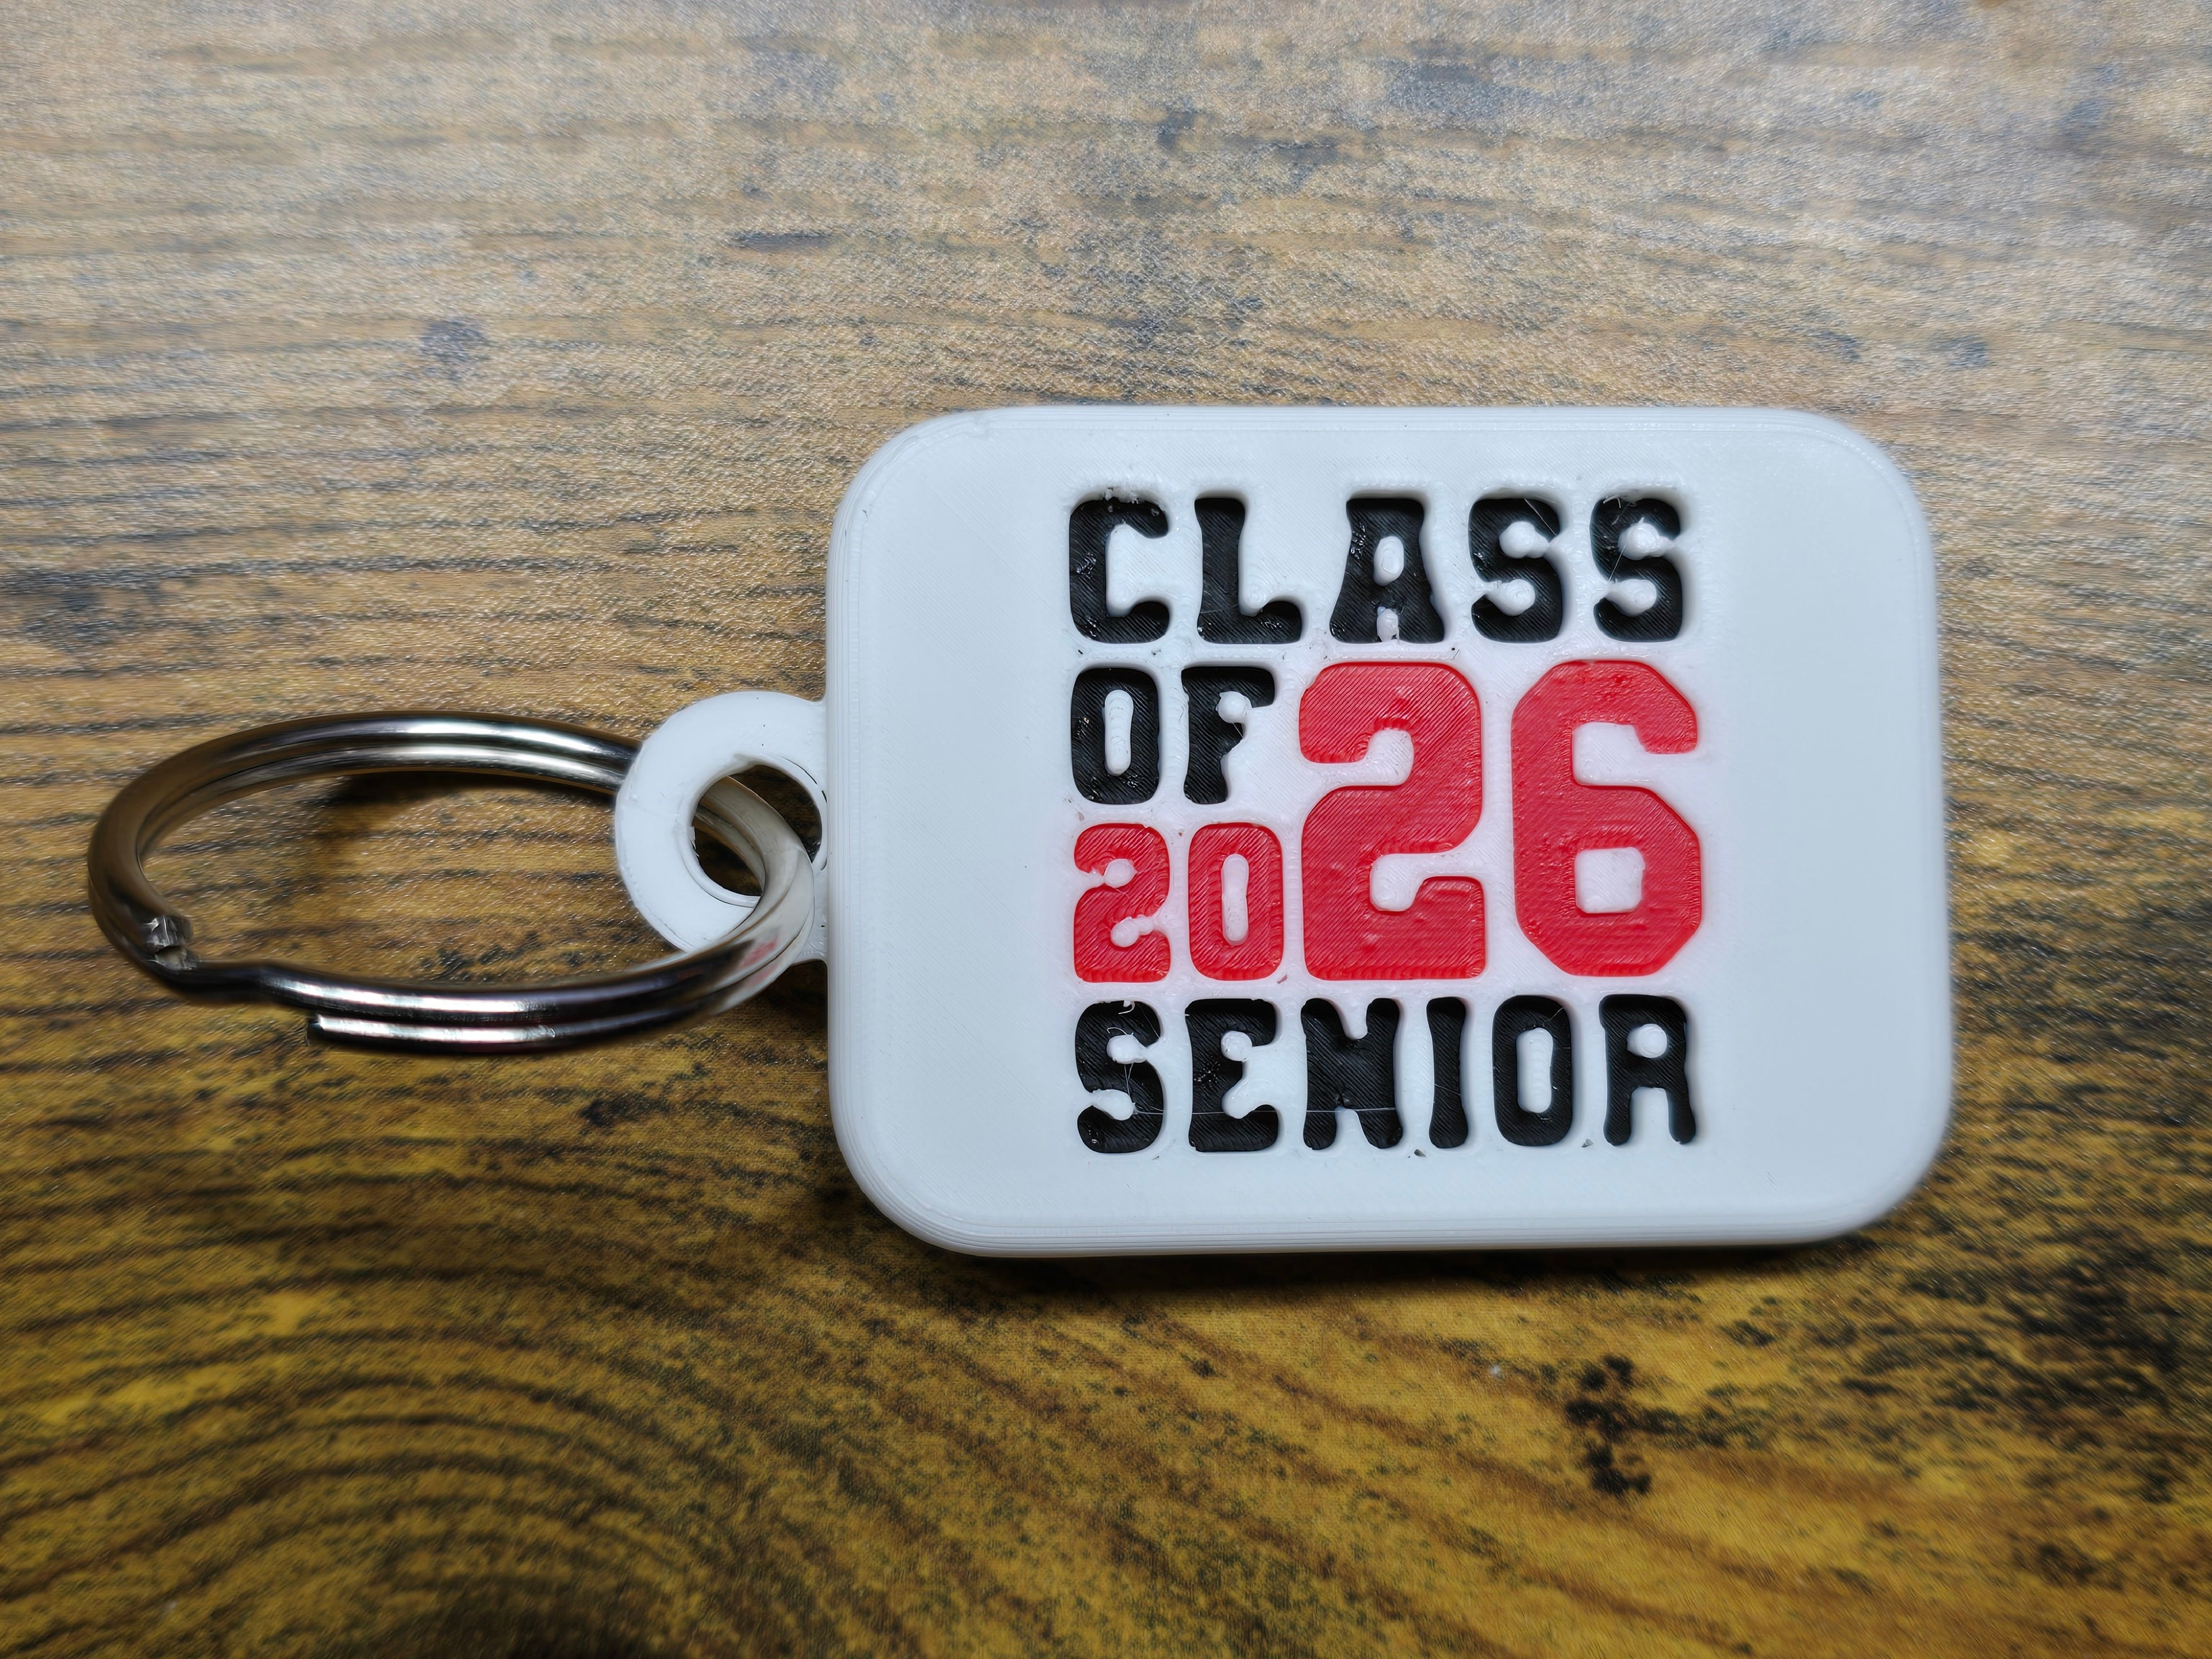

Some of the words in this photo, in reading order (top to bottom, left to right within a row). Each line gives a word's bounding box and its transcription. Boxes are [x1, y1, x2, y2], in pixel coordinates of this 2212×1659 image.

[1069, 494, 1685, 644] CLASS
[1070, 665, 1276, 805] OF
[1298, 660, 1703, 981] 26
[1073, 823, 1285, 983] 20
[1075, 994, 1698, 1154] SENIOR
